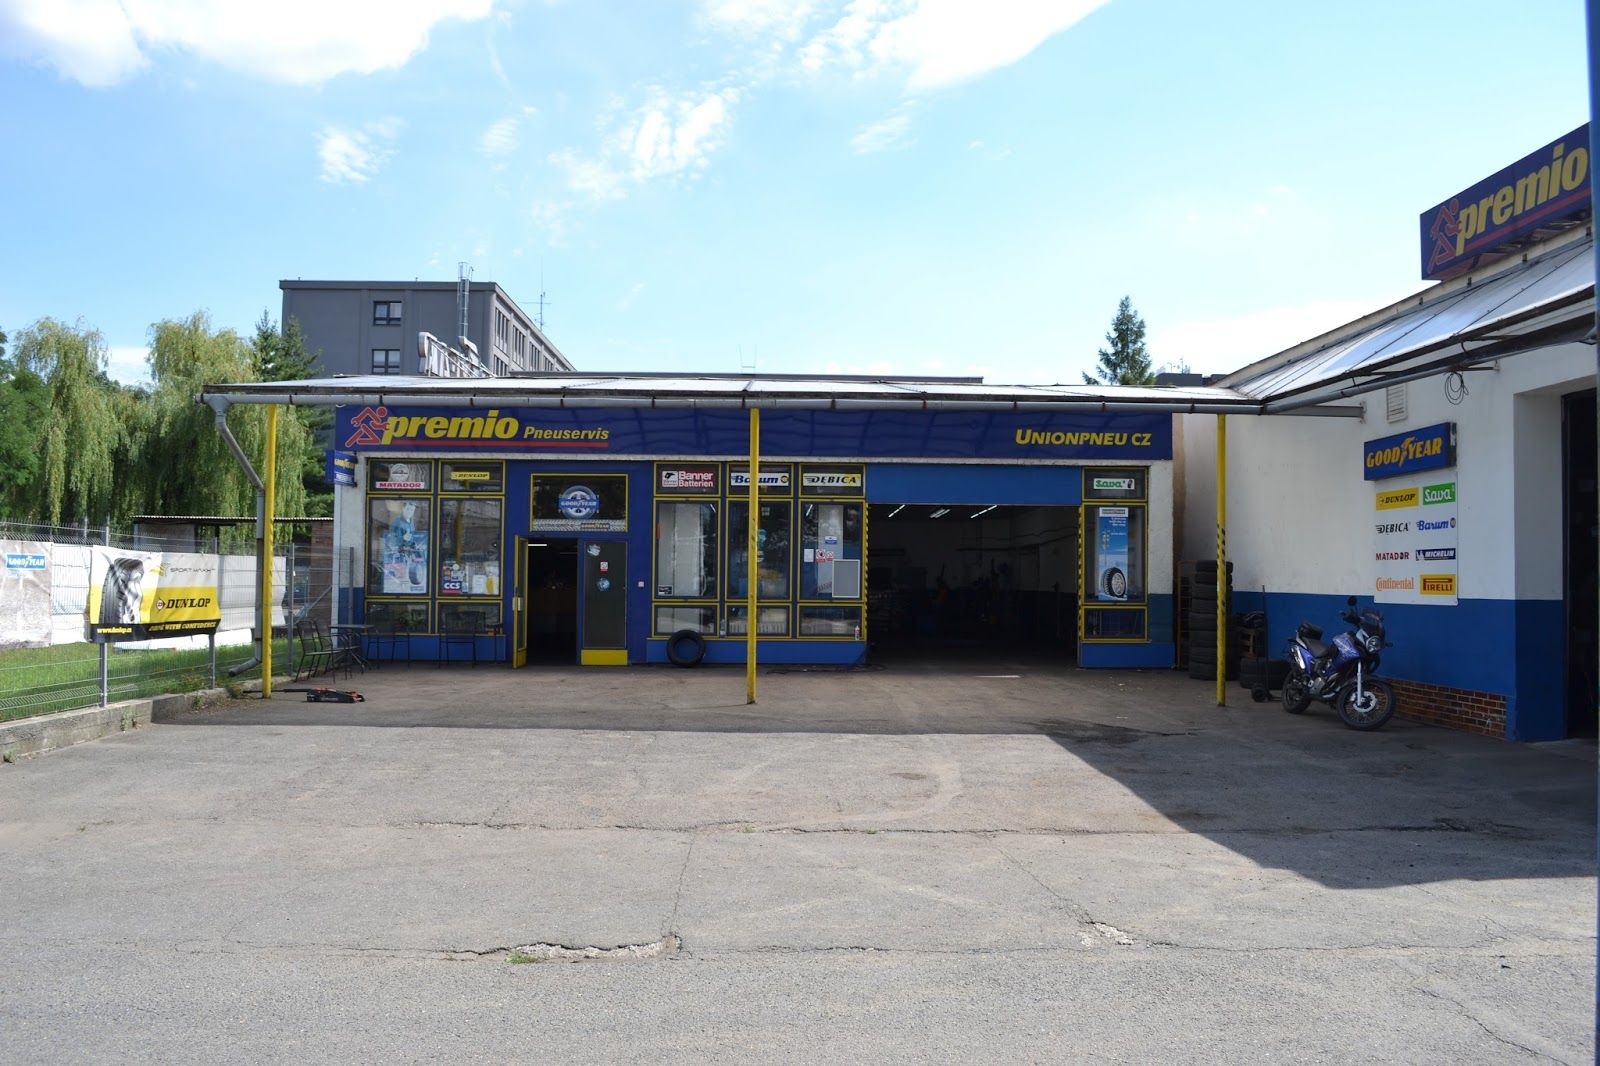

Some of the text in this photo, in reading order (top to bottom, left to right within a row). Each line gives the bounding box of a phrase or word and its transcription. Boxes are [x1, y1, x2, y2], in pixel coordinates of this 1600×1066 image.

[1456, 142, 1588, 256] premio
[381, 410, 609, 445] premio Pneuservis
[1015, 429, 1152, 446] UNIONPNEU CZ
[679, 471, 714, 480] Banner
[732, 475, 779, 483] Baum
[1095, 480, 1122, 488] Sava
[1384, 493, 1415, 504] DUNLOP
[1425, 488, 1451, 502] Sava
[1417, 520, 1449, 531] Barum
[1376, 552, 1410, 560] MATADOR
[1376, 577, 1414, 591] Continental
[1423, 578, 1453, 591] PIRELLI
[166, 598, 211, 608] DUNLOP
